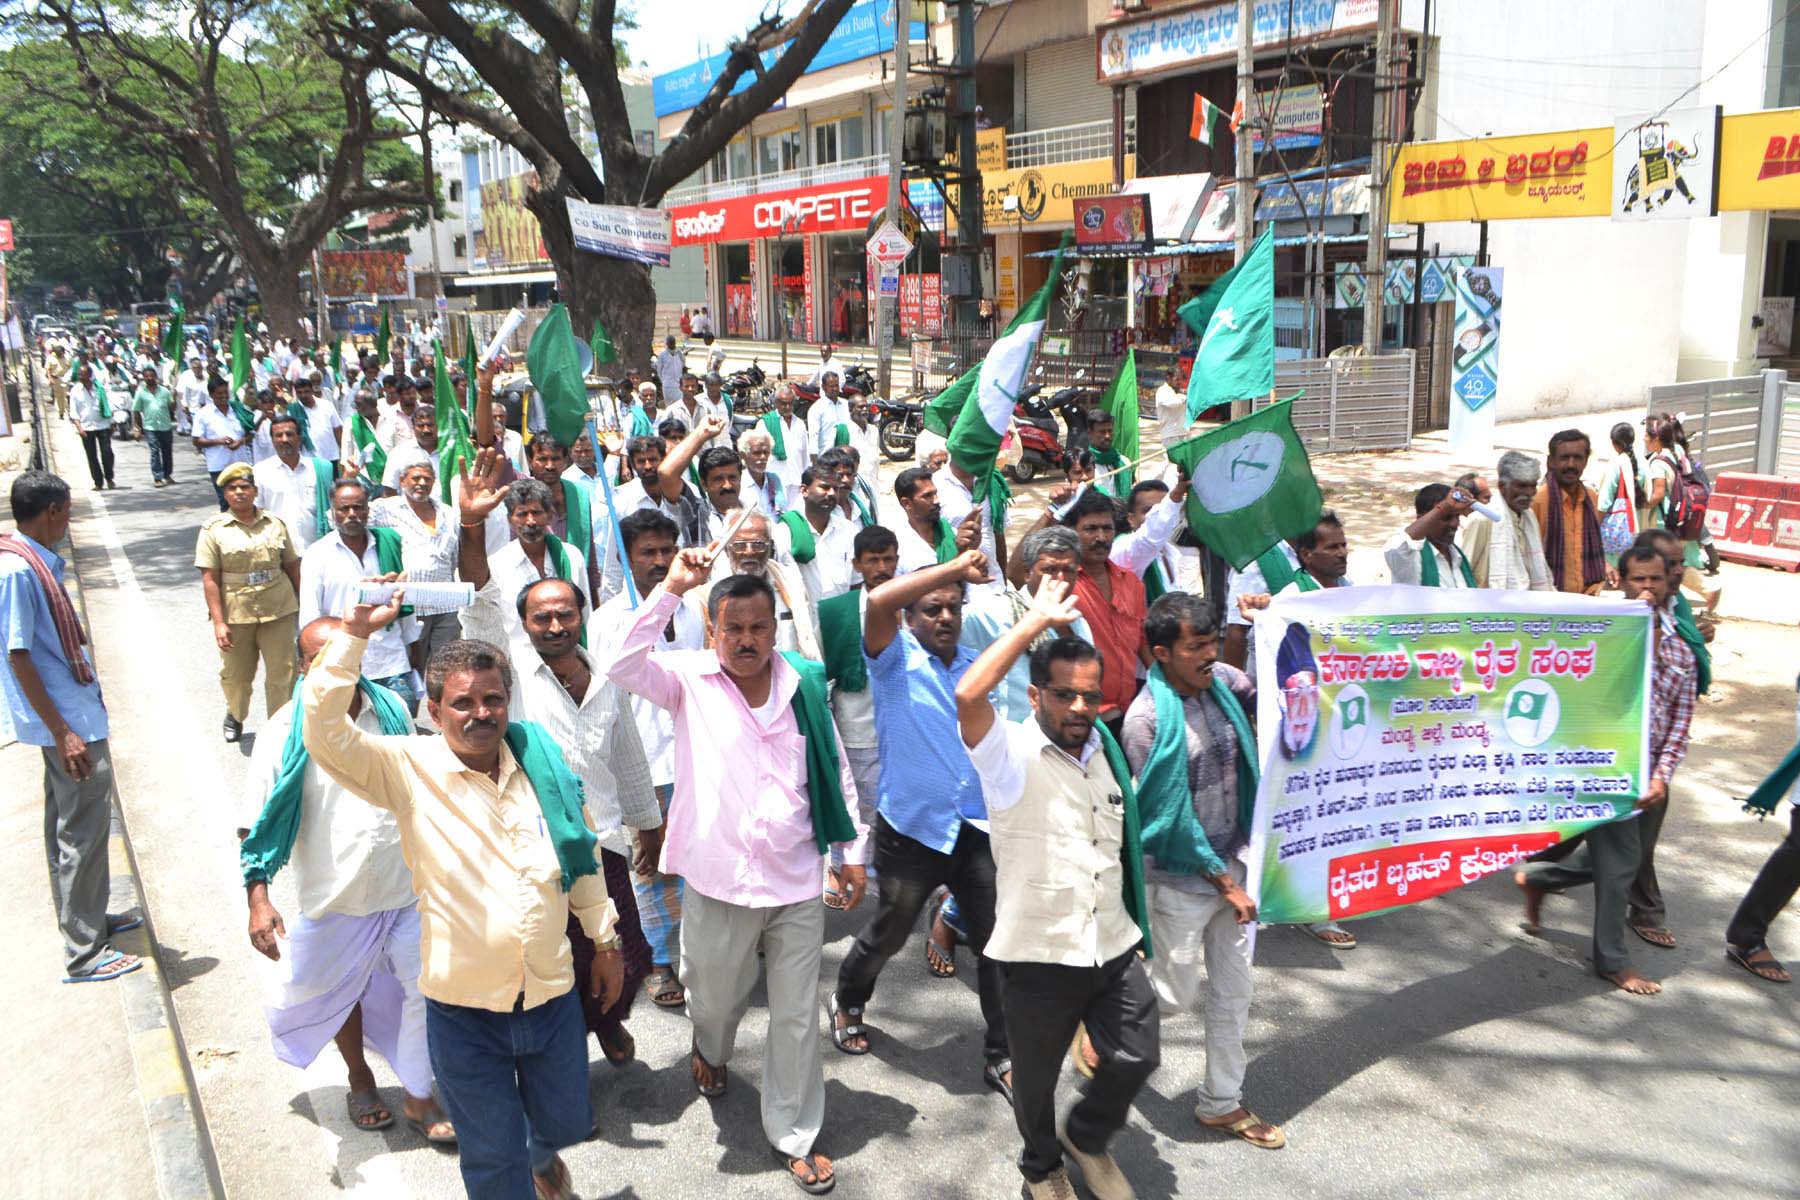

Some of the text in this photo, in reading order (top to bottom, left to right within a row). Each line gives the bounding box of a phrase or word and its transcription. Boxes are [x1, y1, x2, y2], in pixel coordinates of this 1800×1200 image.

[753, 188, 872, 229] COMPETE
[592, 219, 611, 233] Sun
[614, 223, 668, 241] Computers
[1317, 641, 1597, 692] ಕರ್ನಾಟಕ ರಾಜ್ಯ ರೈತ ಸಂಘ
[1381, 726, 1415, 753] ಮಂಡ್ಯ
[1428, 753, 1457, 779] ರೈತರ
[1521, 751, 1549, 767] ಸಾಲ
[1330, 859, 1381, 909] ರೈತರ
[1387, 851, 1452, 897] ಬೃಹತ್
